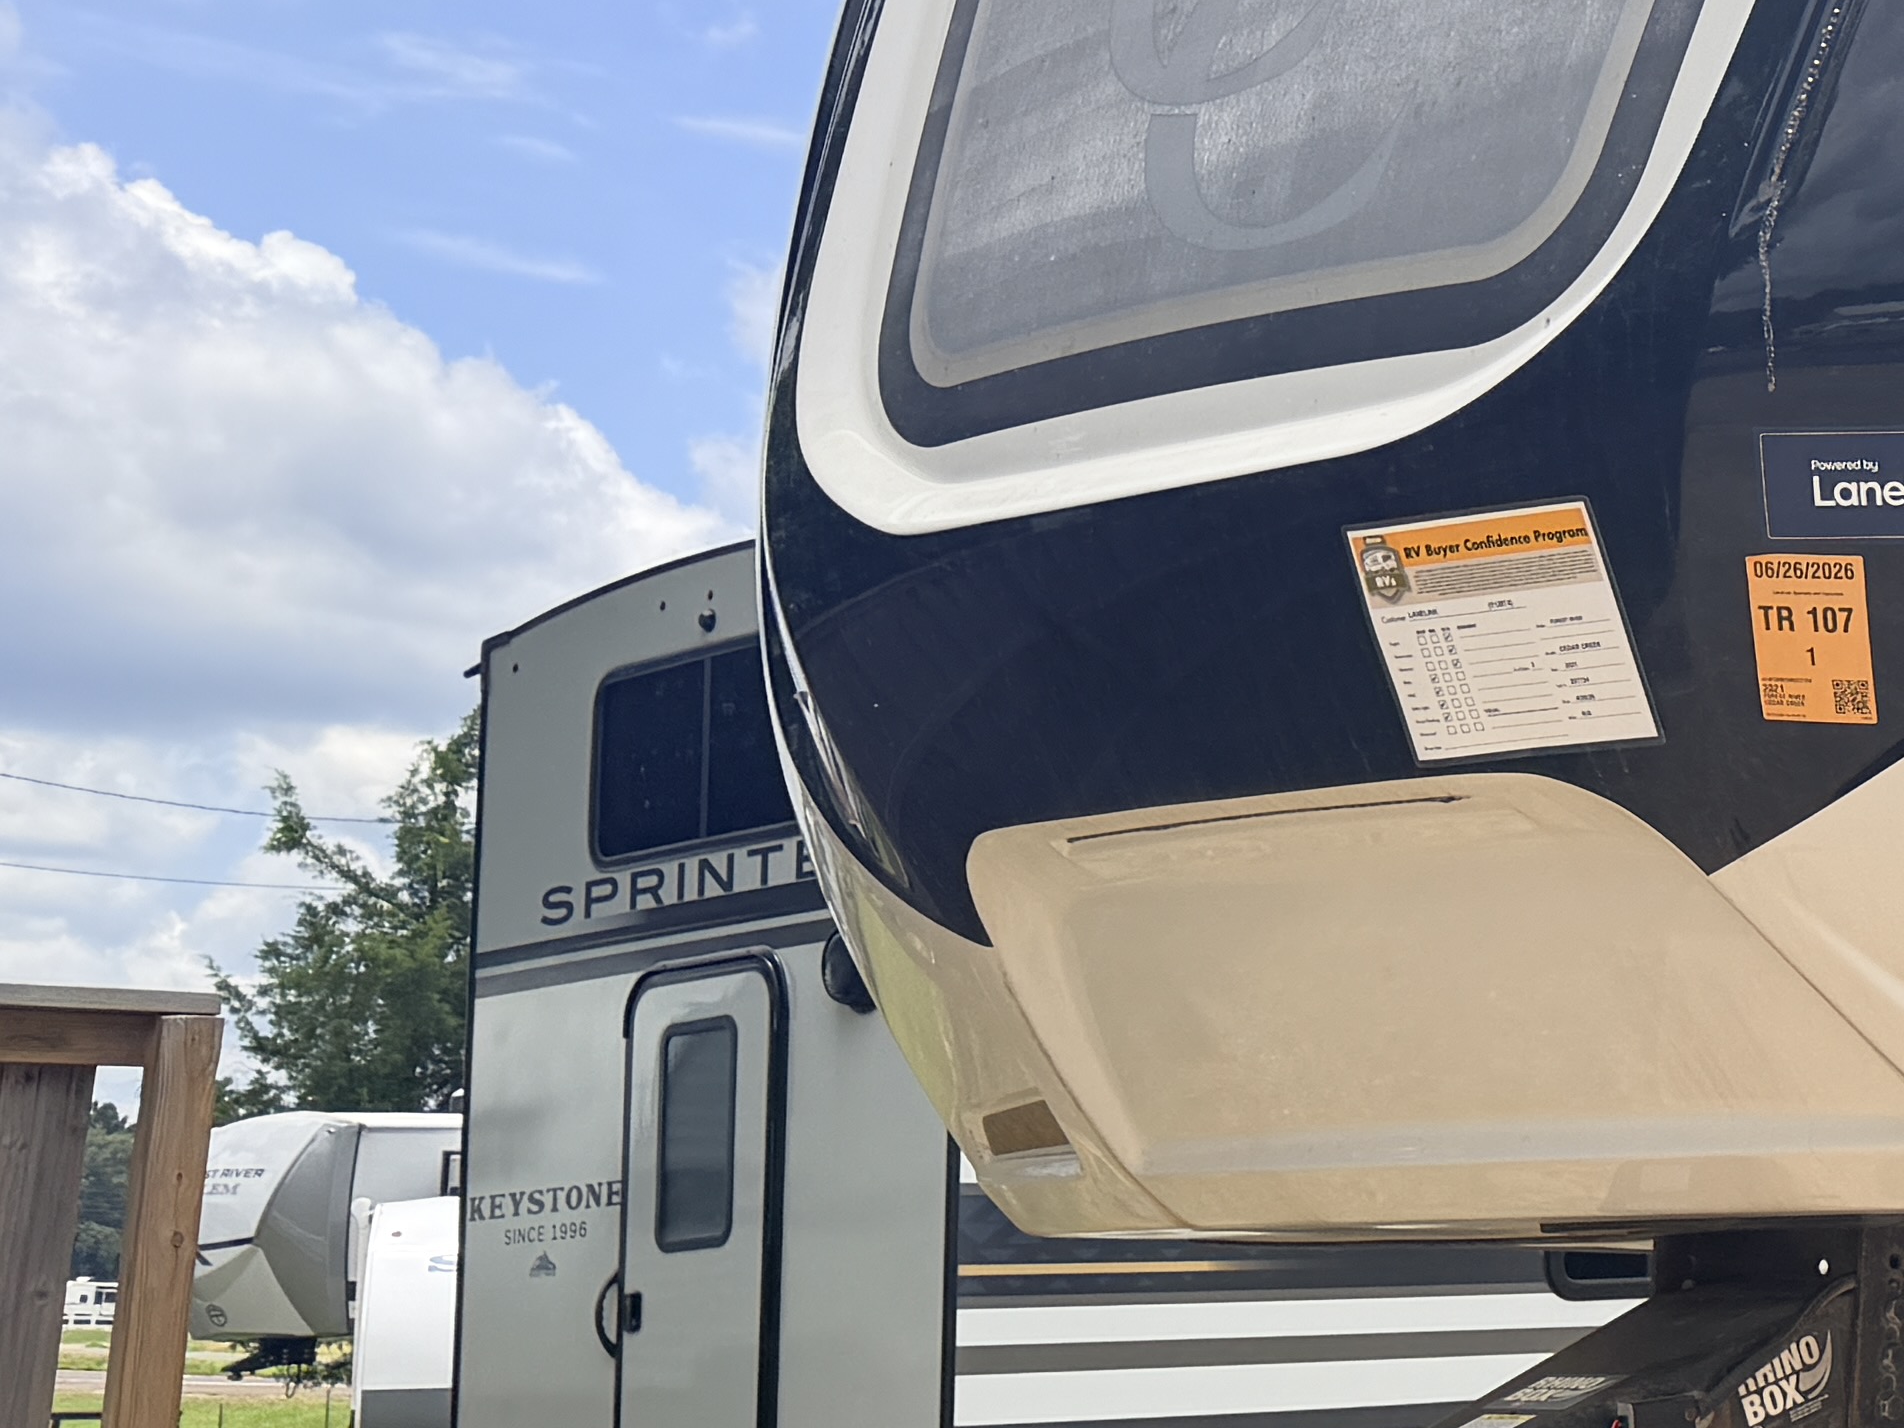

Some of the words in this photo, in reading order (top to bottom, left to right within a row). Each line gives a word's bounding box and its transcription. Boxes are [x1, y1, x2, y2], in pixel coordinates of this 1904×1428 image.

[1811, 459, 1861, 471] Powered
[1863, 459, 1879, 473] by
[1404, 545, 1421, 560] RV
[1425, 540, 1460, 559] Buyer
[1463, 533, 1531, 552] Confidence
[1534, 527, 1589, 545] Program
[1753, 561, 1855, 580] 06/26/2026
[1758, 605, 1796, 633] TR
[1806, 606, 1854, 633] 107
[1805, 647, 1816, 666] 1
[220, 1168, 265, 1178] RIVER
[469, 1179, 622, 1223] KEYSTONE
[504, 1225, 545, 1246] SINCE
[551, 1221, 588, 1241] 1996
[1741, 1374, 1805, 1427] BOX
